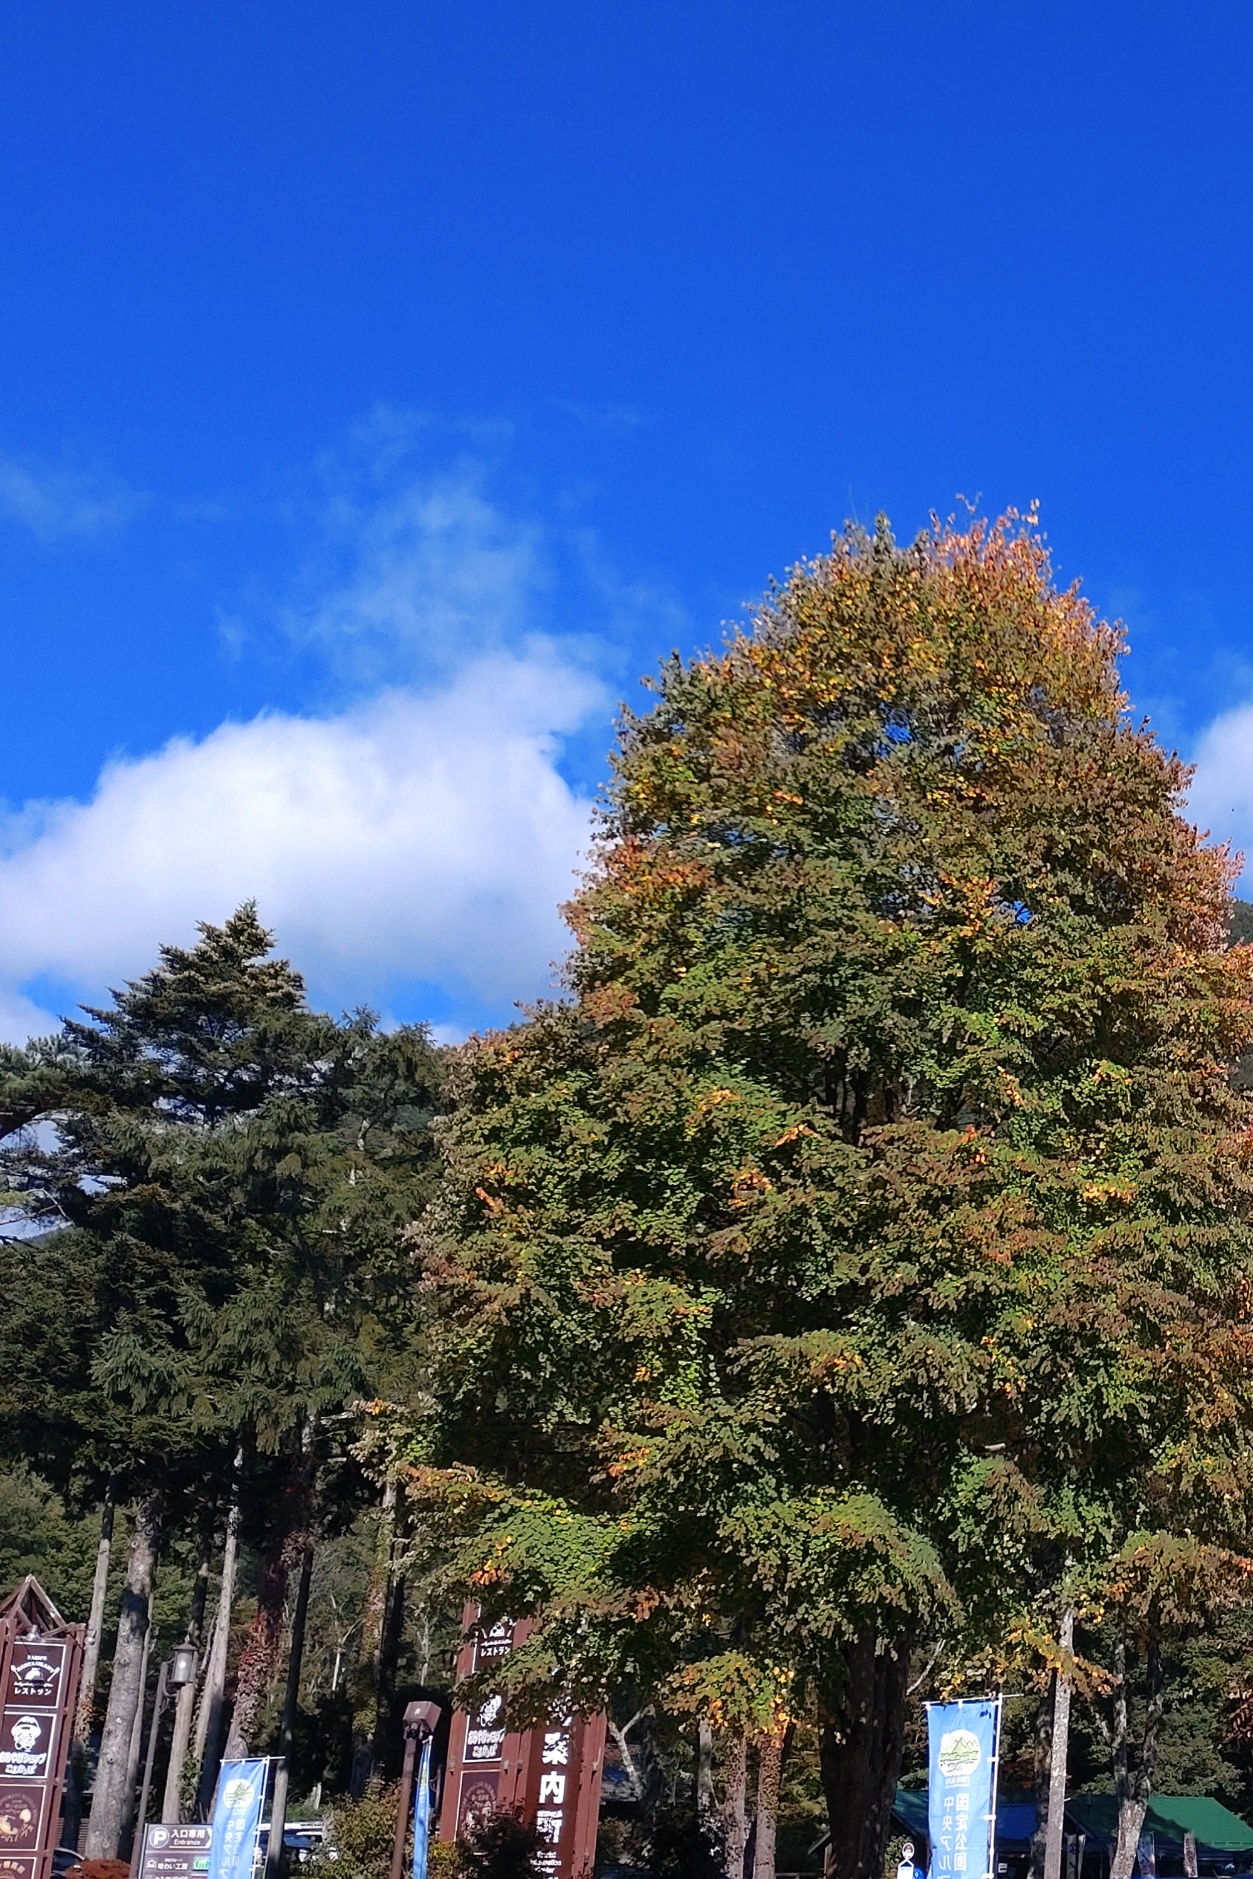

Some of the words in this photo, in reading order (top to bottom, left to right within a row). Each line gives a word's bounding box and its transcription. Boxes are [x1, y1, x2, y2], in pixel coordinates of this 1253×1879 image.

[480, 1646, 511, 1657] レストラン
[14, 1687, 52, 1696] レストラン
[170, 1828, 206, 1839] 入口専用
